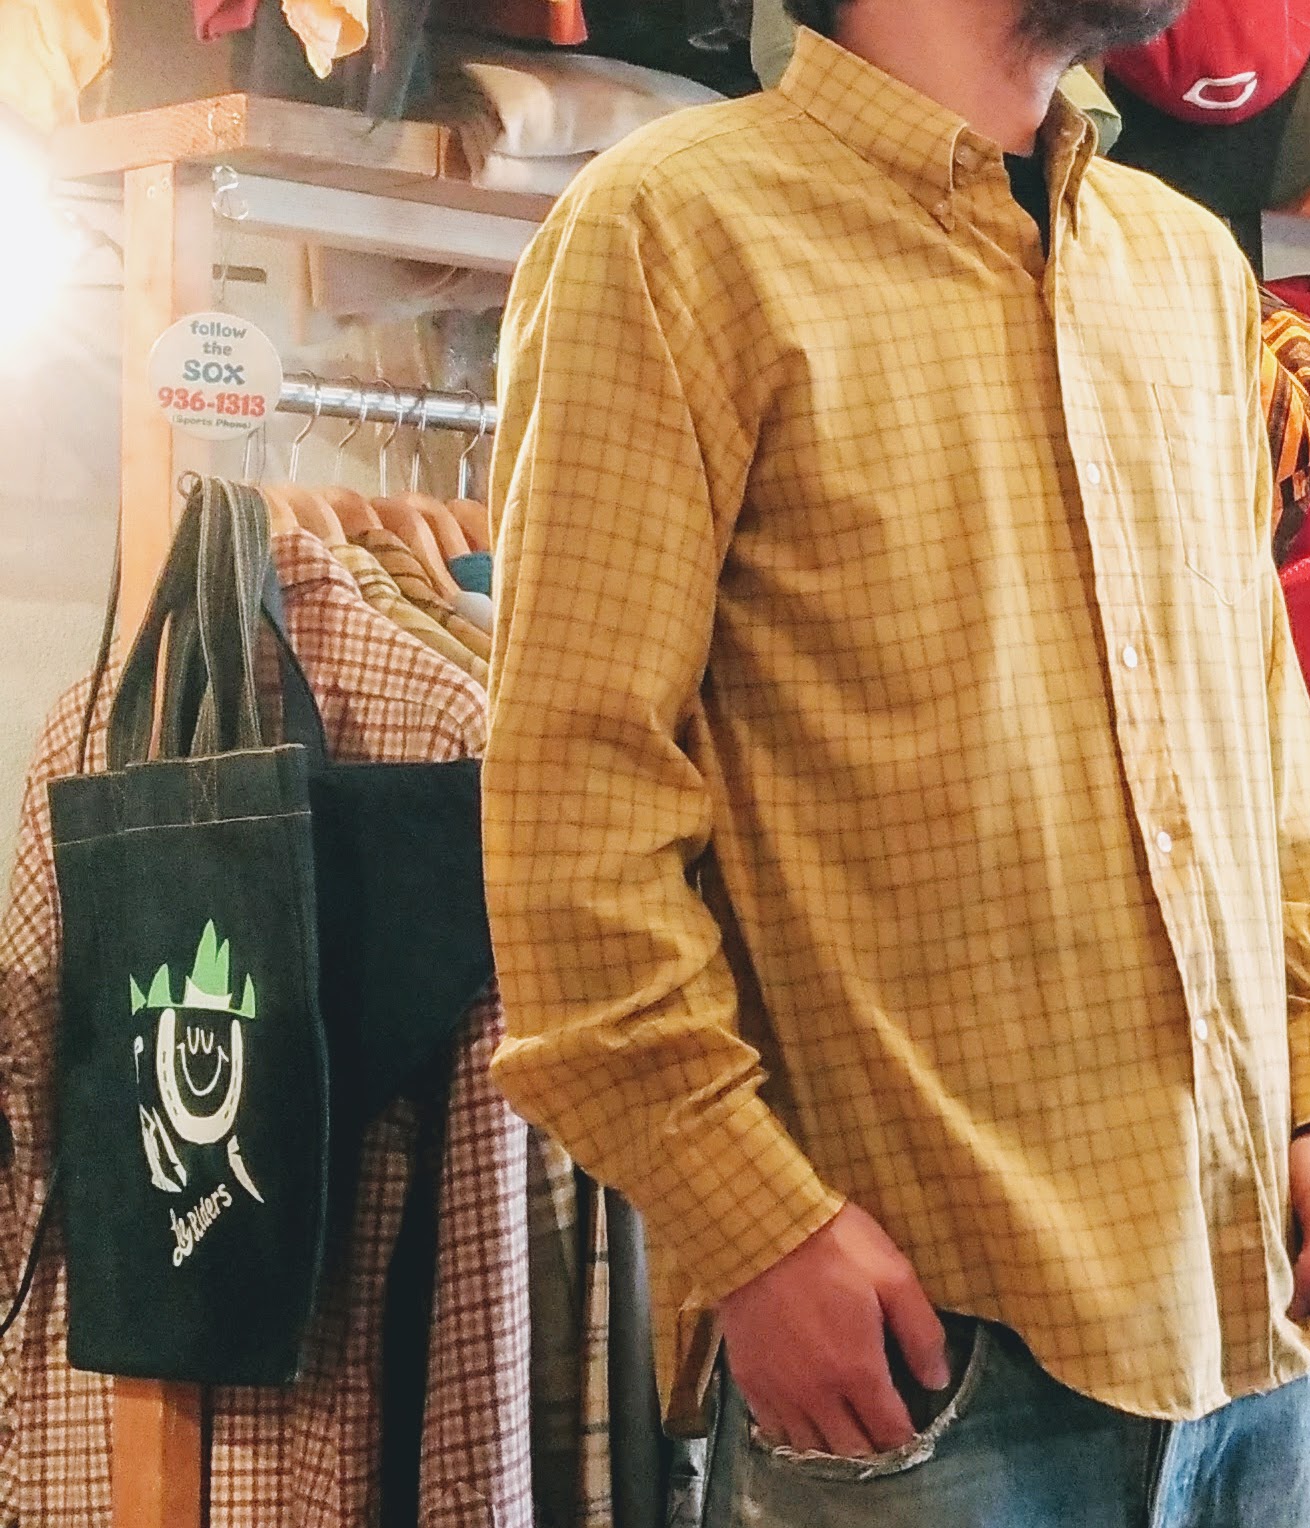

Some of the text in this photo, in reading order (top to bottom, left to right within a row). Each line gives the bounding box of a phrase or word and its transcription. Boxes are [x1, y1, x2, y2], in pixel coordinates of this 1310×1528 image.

[190, 320, 247, 338] follow
[202, 341, 233, 356] the
[158, 386, 265, 417] 936-1313
[172, 414, 251, 429] (Sports Phone)
[186, 1183, 233, 1242] Riders
